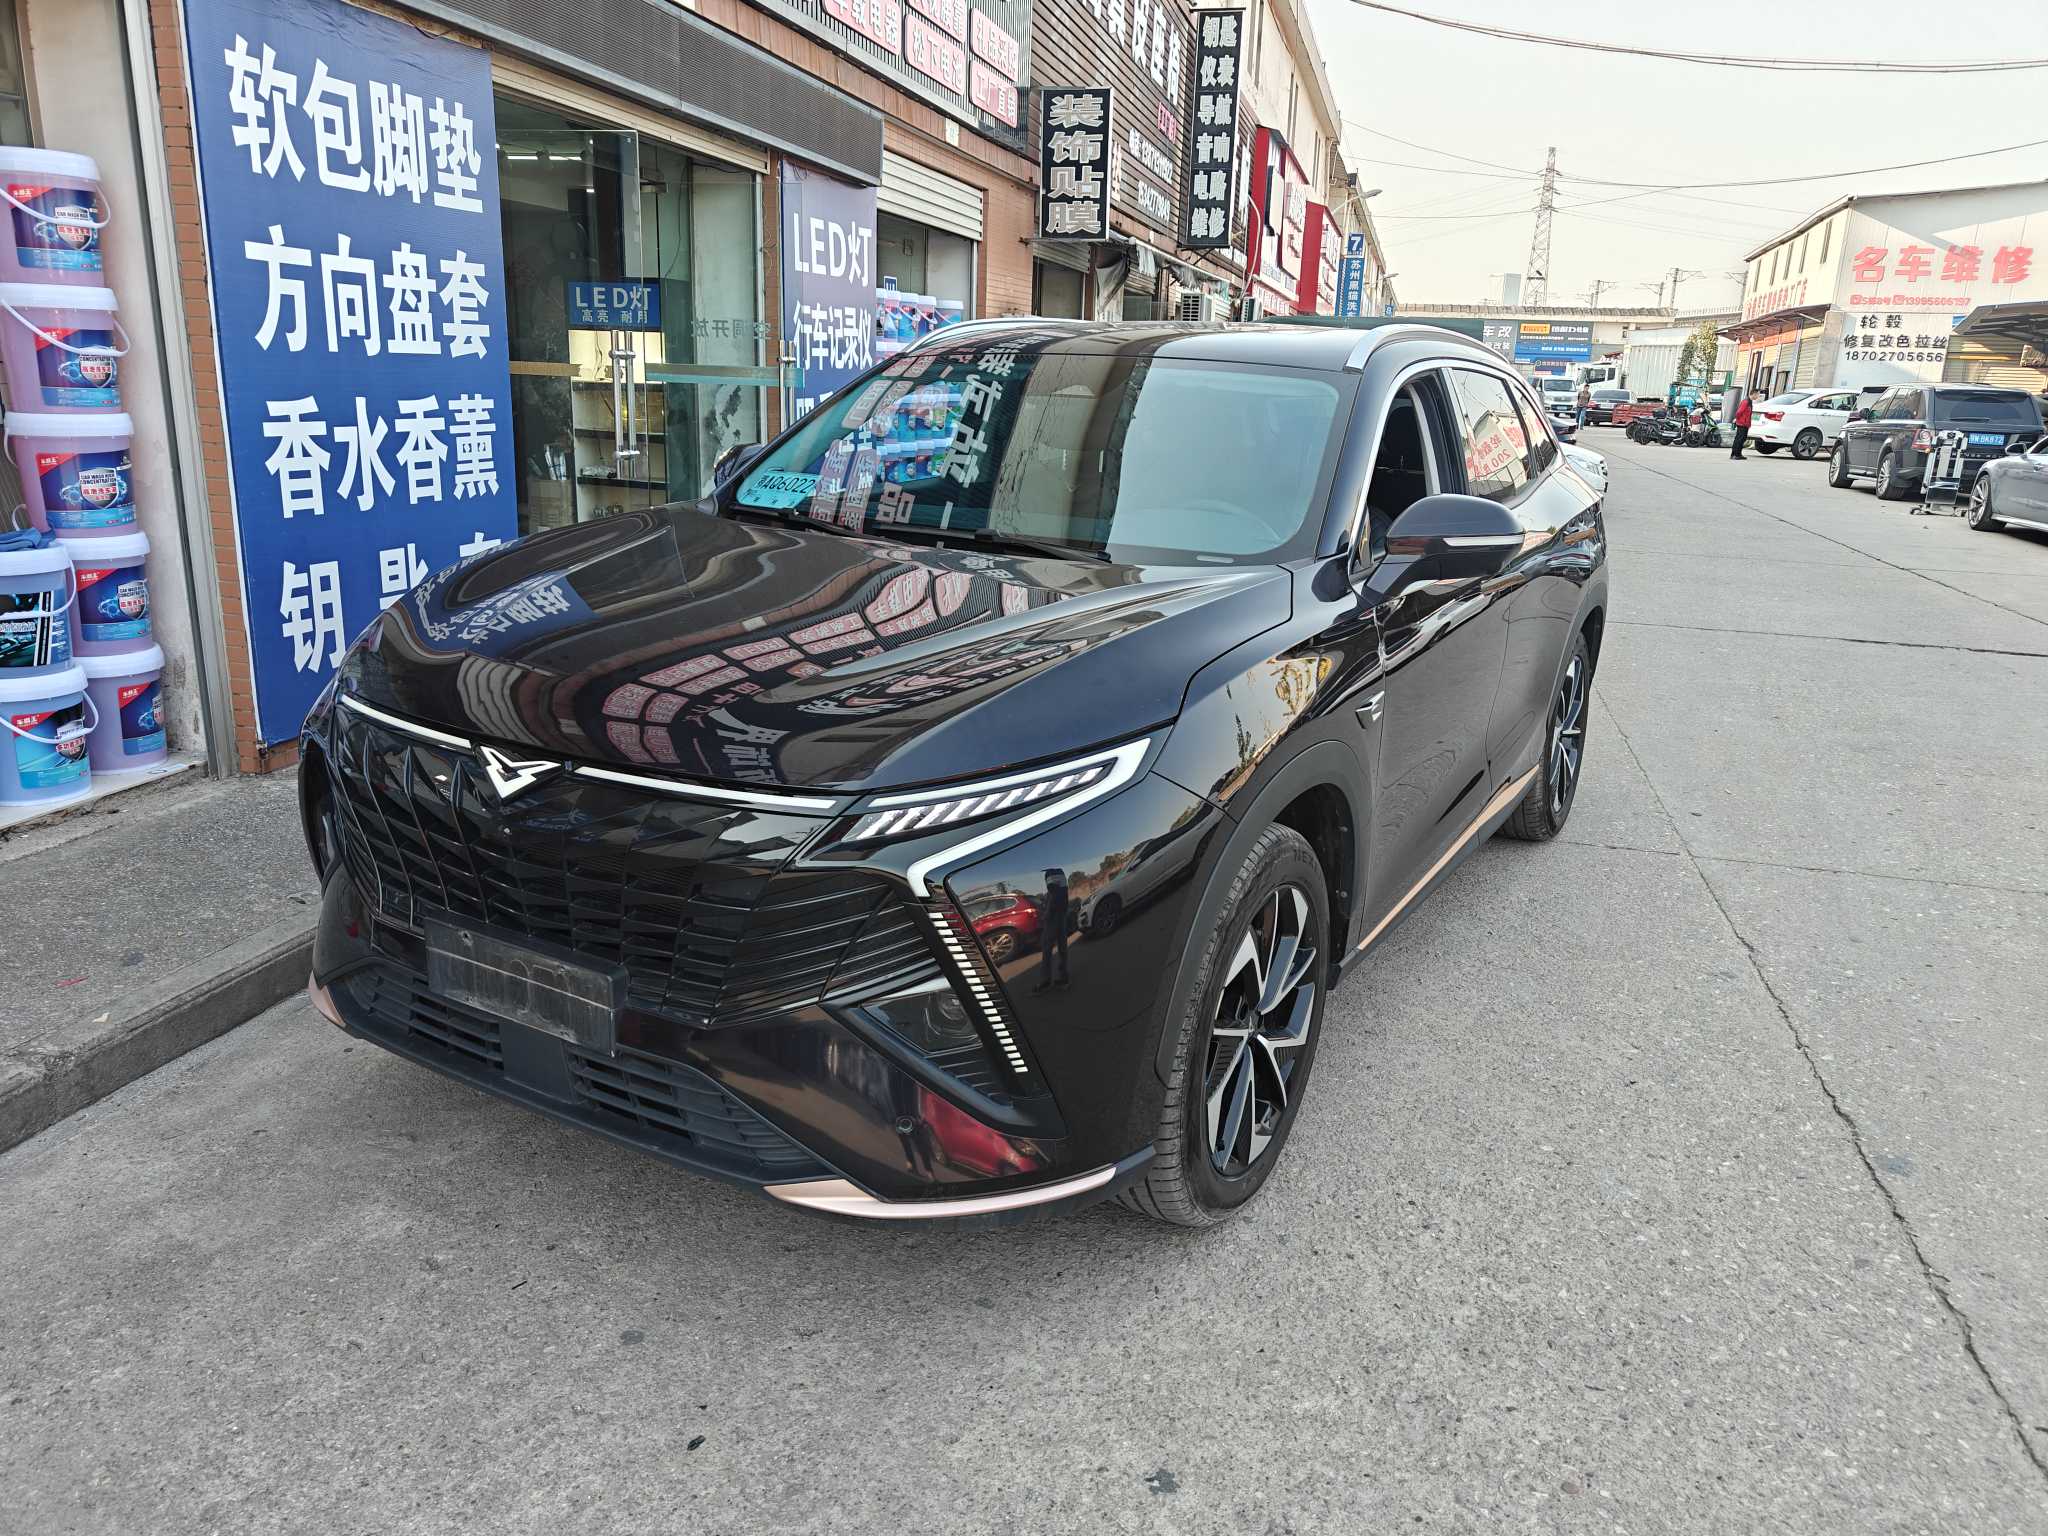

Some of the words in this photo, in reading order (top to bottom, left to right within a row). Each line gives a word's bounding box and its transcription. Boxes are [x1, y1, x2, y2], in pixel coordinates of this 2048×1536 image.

[224, 33, 484, 213] 软包脚垫
[1047, 93, 1105, 234] 装饰贴膜
[1193, 169, 1228, 201] 电路
[1190, 206, 1226, 239] 维修
[793, 212, 872, 287] LED灯
[1851, 245, 2034, 284] 名车维修
[244, 223, 490, 360] 方向盘套
[576, 285, 652, 311] LED灯
[581, 309, 609, 323] 高亮
[793, 299, 873, 370] 行车记录仪
[1843, 333, 1949, 350] 修复改色拉丝
[1845, 350, 1944, 363] 18702705656
[262, 393, 499, 519] 香水香薰
